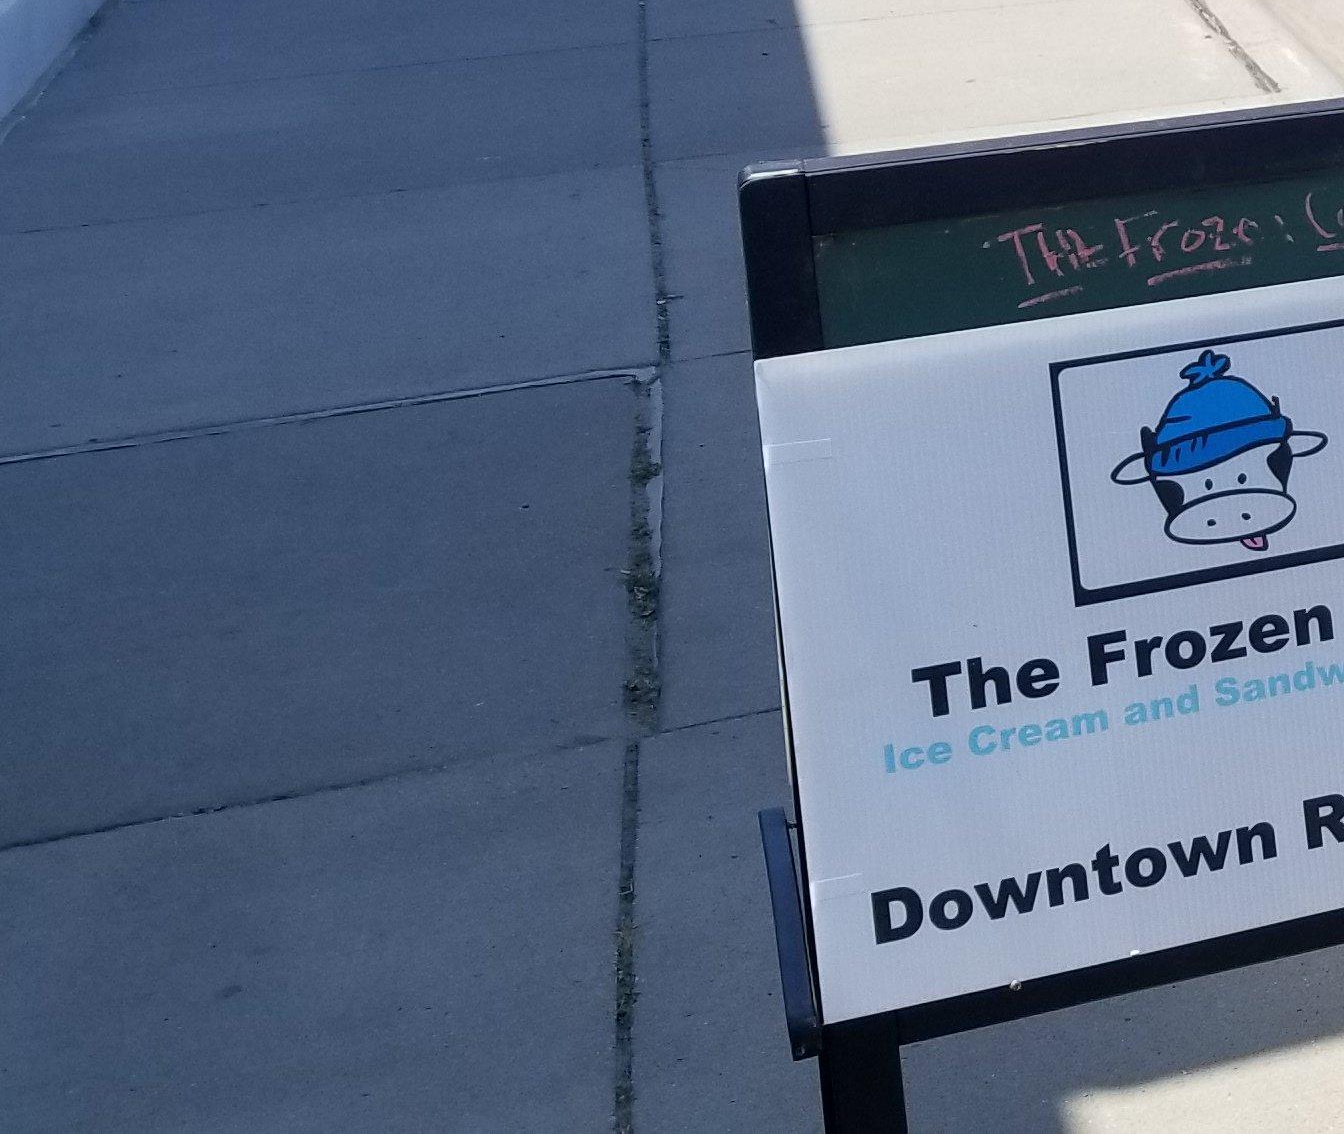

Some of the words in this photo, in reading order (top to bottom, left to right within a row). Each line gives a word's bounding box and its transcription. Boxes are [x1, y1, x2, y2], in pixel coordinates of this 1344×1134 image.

[911, 656, 1060, 718] The
[1086, 604, 1334, 687] Frozen
[883, 740, 952, 773] Ice
[967, 709, 1110, 757] Cream
[1124, 684, 1201, 727] and
[870, 821, 1278, 945] Downtown
